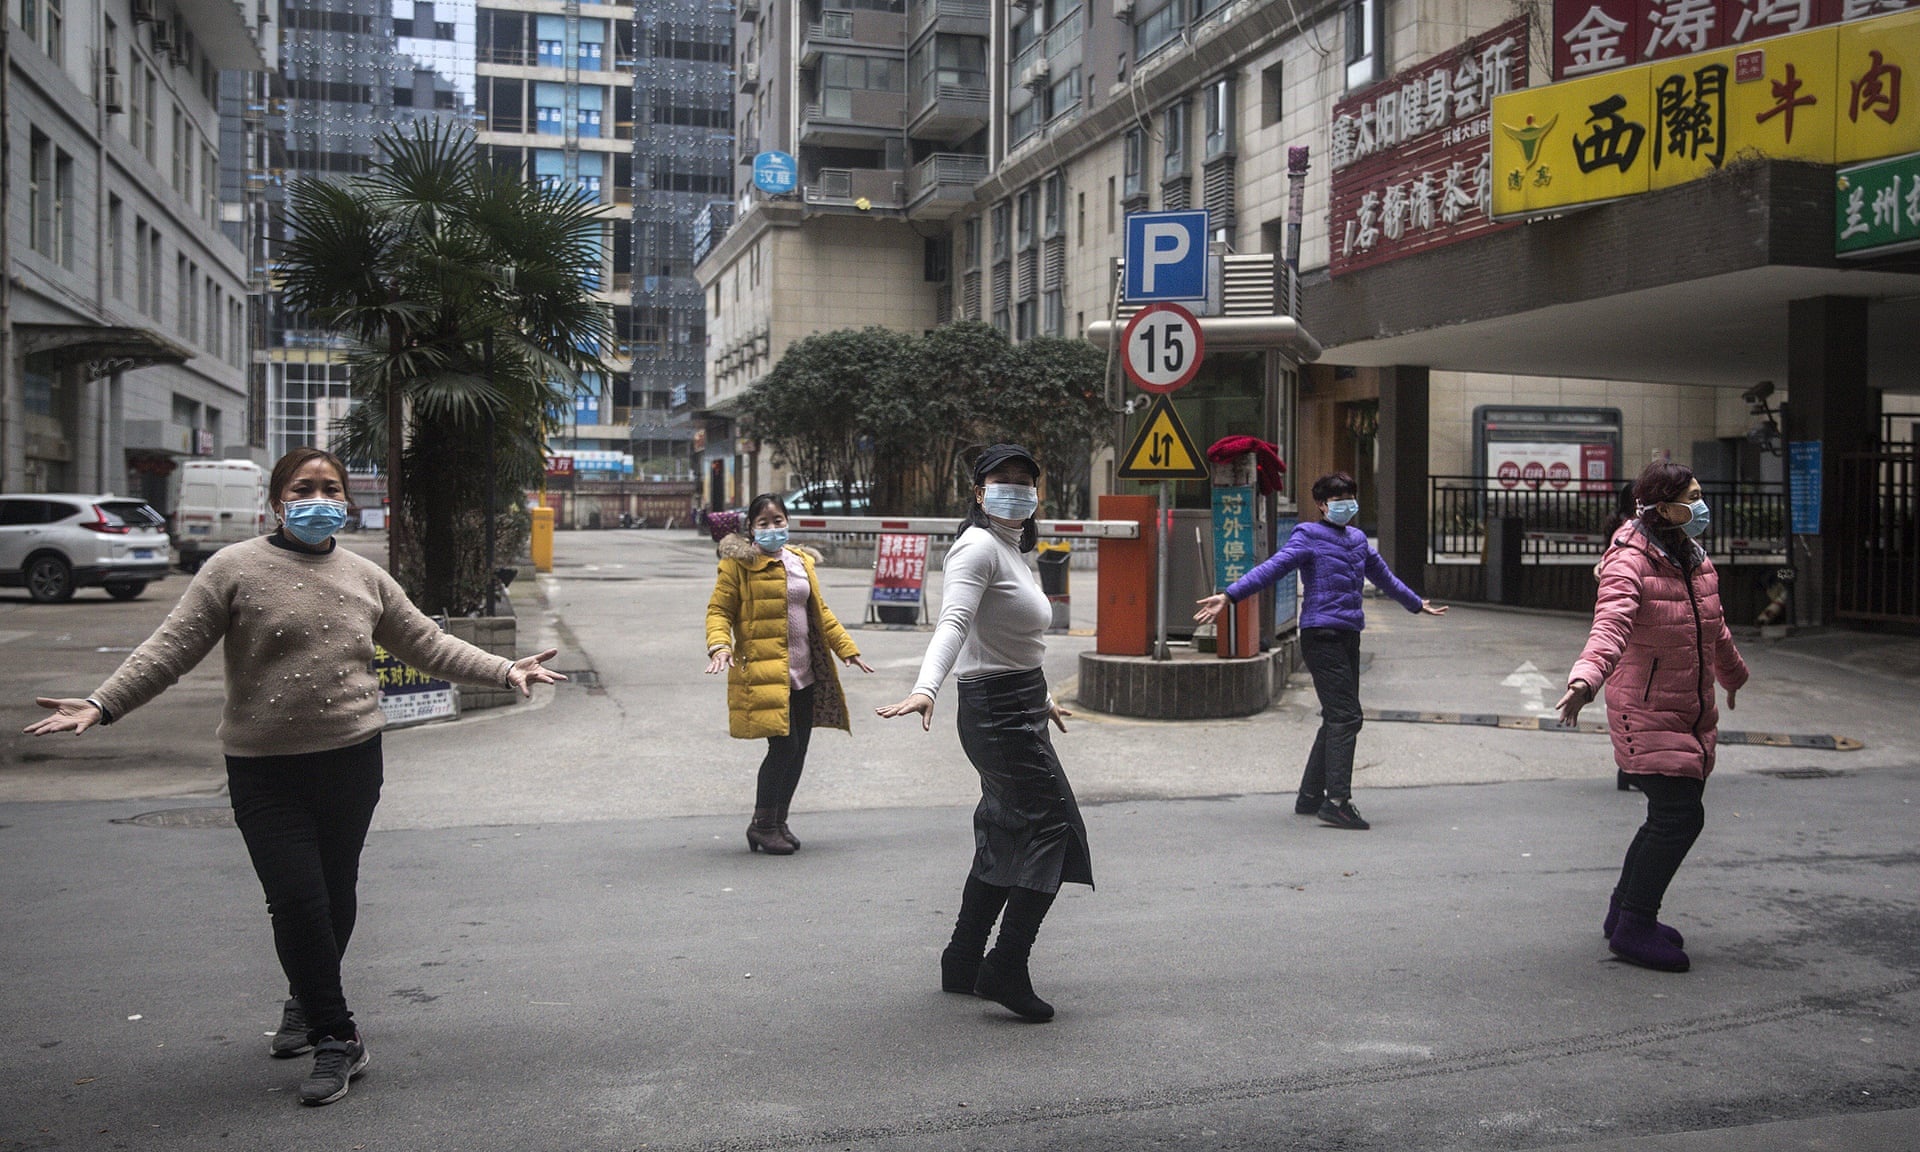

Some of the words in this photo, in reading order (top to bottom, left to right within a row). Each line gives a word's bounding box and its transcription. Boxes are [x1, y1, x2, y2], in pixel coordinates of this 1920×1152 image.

[1332, 37, 1516, 168] 鑫太阳健身会所
[759, 170, 791, 185] 汉庭
[1142, 222, 1190, 293] P
[1140, 323, 1183, 373] 15
[1221, 493, 1246, 582] 对外停车
